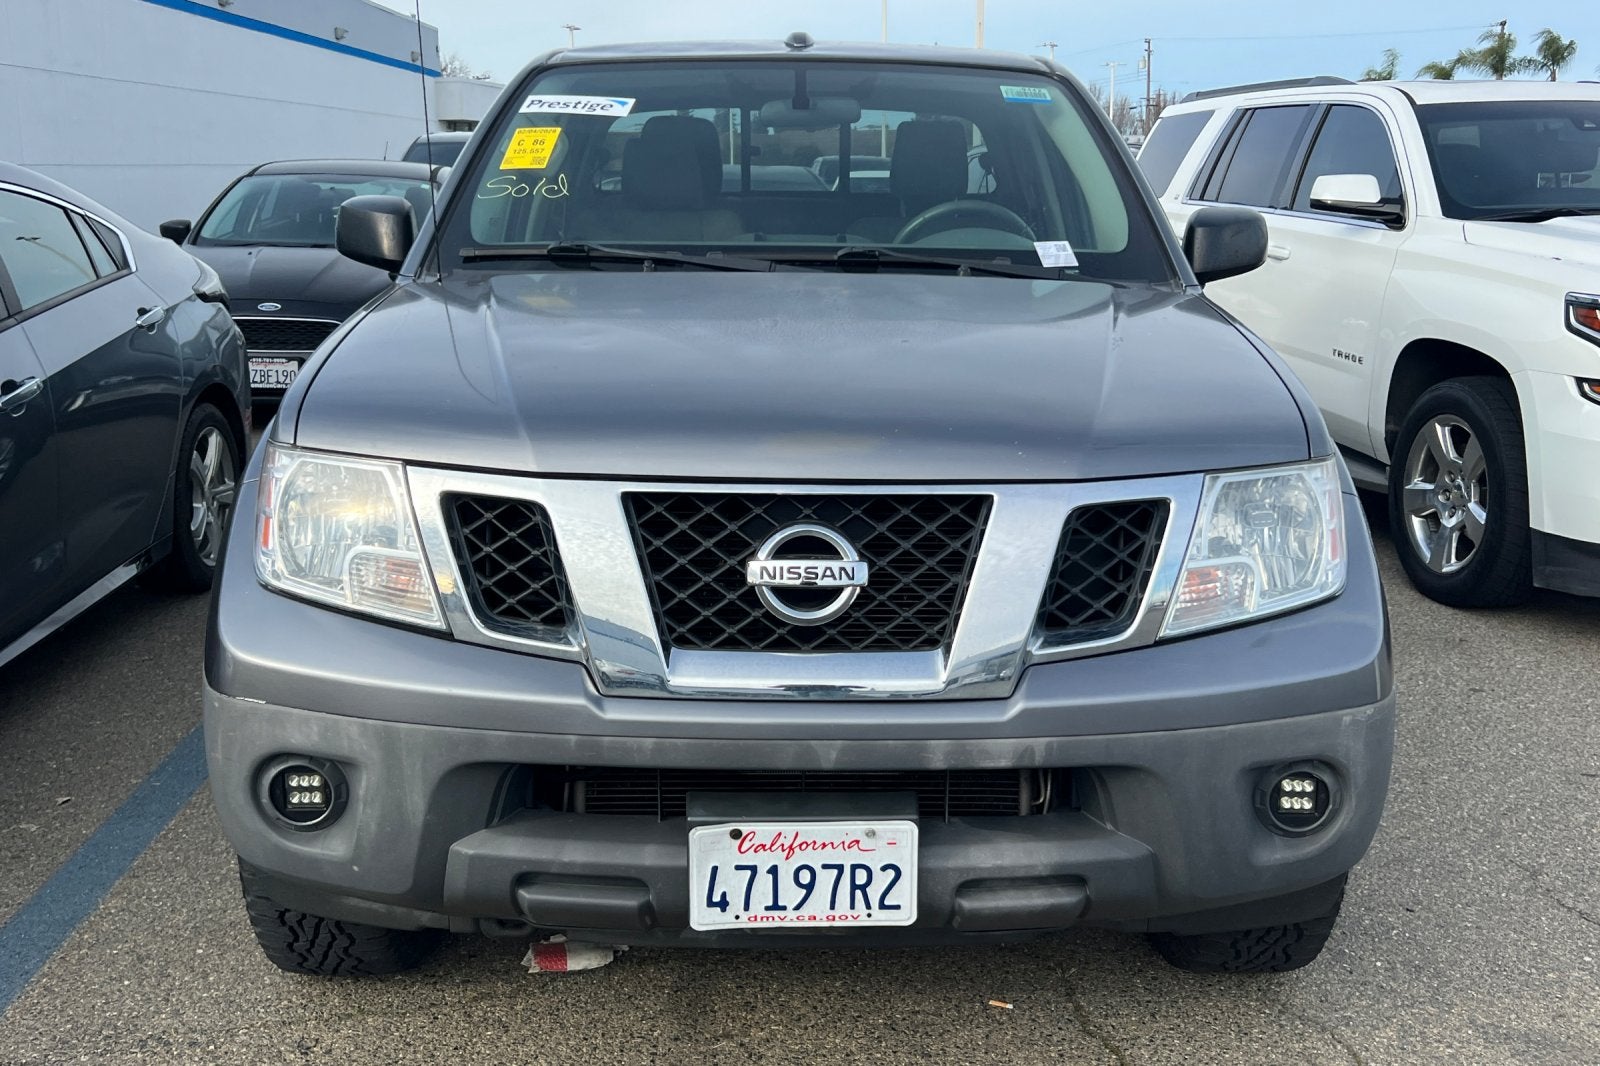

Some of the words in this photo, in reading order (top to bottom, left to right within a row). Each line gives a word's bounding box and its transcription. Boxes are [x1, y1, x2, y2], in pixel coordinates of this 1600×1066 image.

[526, 98, 613, 112] Prestige
[532, 138, 546, 146] 86
[477, 173, 570, 199] Sold
[1332, 348, 1364, 365] TAHOE
[760, 566, 855, 581] NISSAN
[737, 830, 876, 861] California
[706, 863, 903, 913] 47197R2
[747, 913, 862, 923] dmv.ca.gov
